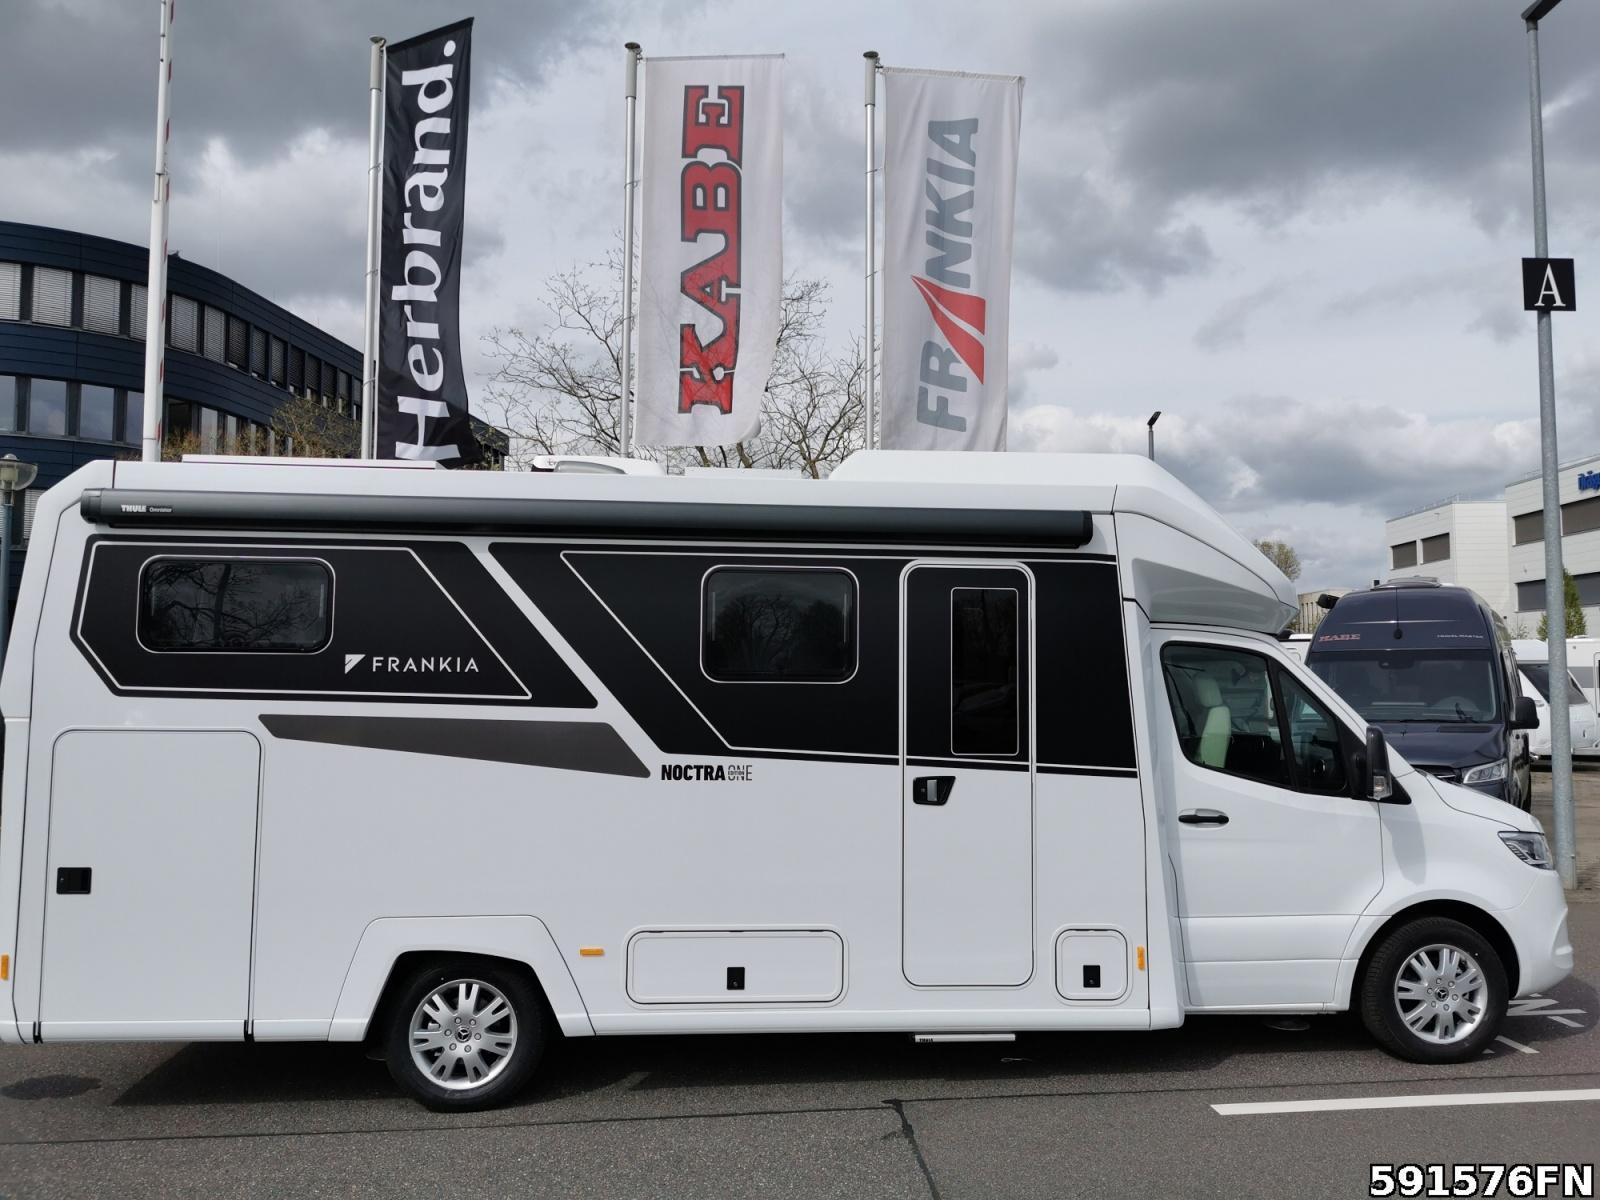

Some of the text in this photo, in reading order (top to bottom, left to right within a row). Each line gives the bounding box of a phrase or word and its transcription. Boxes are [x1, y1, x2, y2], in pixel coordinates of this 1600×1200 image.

[391, 38, 460, 461] Herbrand.
[677, 84, 745, 416] KABE
[1534, 263, 1566, 306] A
[121, 504, 147, 512] THULE
[372, 656, 479, 673] FRANKIA
[661, 764, 726, 781] NOCTRA
